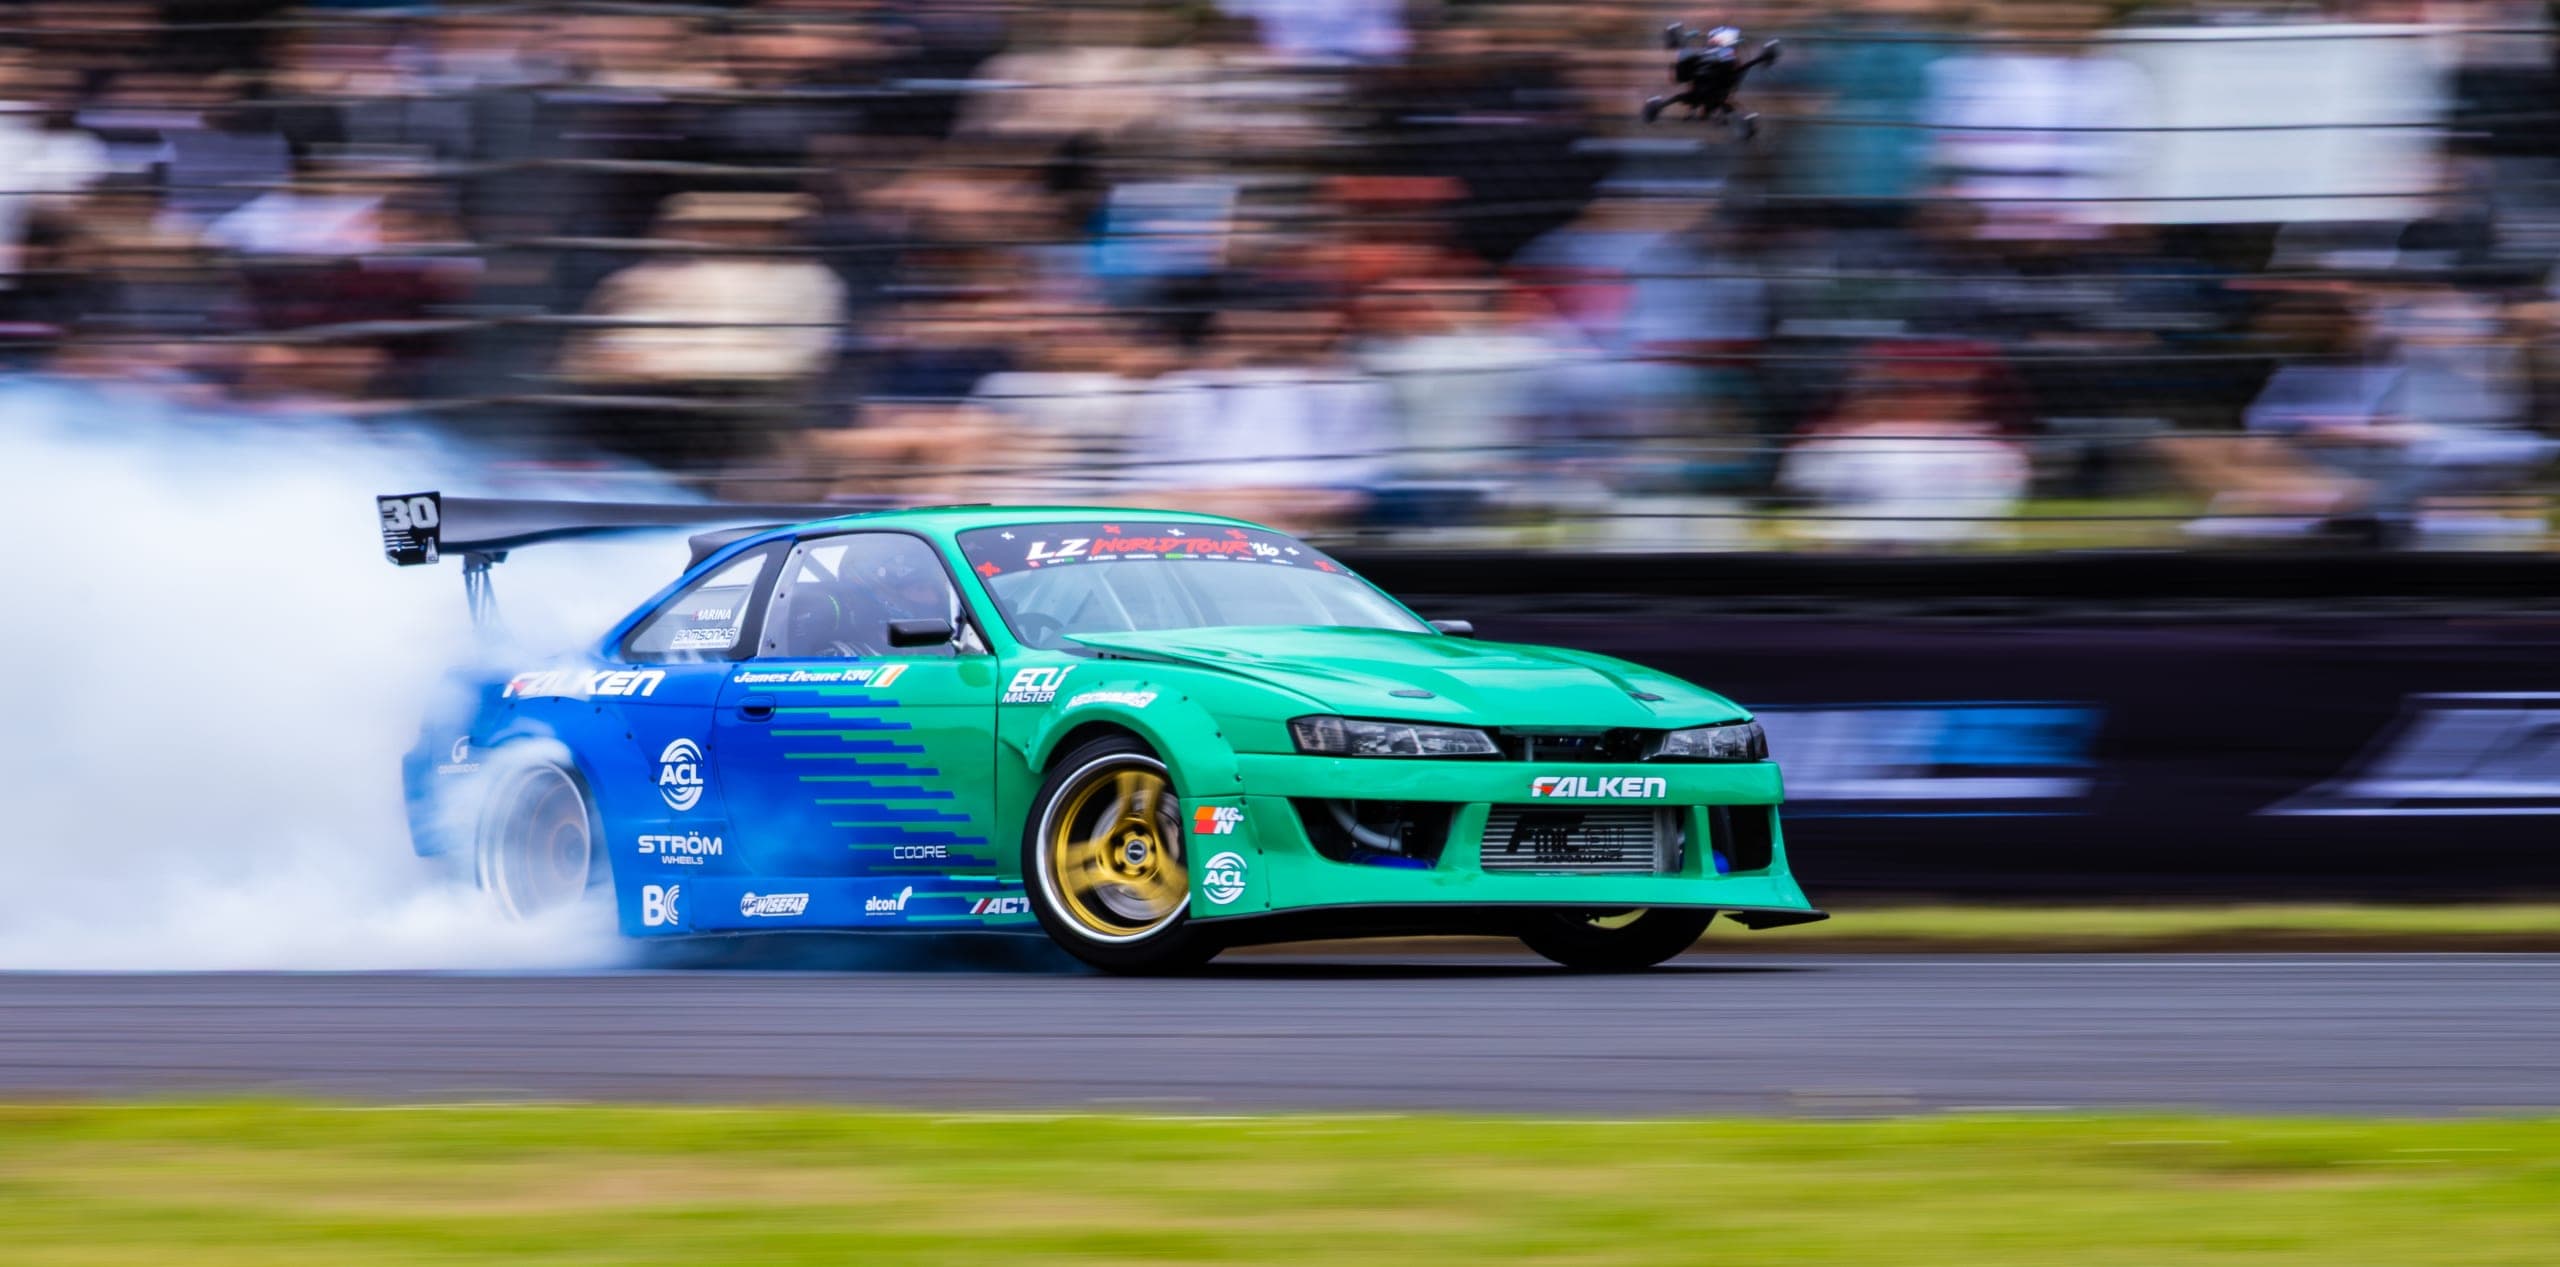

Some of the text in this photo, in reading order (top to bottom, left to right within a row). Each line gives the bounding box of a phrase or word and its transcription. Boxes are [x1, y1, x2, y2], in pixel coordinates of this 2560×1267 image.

[382, 497, 439, 530] 30
[1026, 538, 1090, 560] LZ
[1090, 537, 1180, 556] WORLD
[1181, 538, 1253, 555] TOUR
[502, 669, 667, 699] FALKEN
[733, 671, 789, 683] James
[788, 670, 842, 682] Deane
[1008, 664, 1078, 692] ECU
[1002, 692, 1056, 703] MASTER
[659, 764, 703, 785] ACL
[1529, 776, 1667, 798] FALKEN
[638, 831, 723, 855] STRÖM
[661, 856, 704, 865] WHEELS
[1203, 870, 1246, 886] ACL
[756, 896, 809, 913] WISEFAB
[865, 896, 897, 911] alcon
